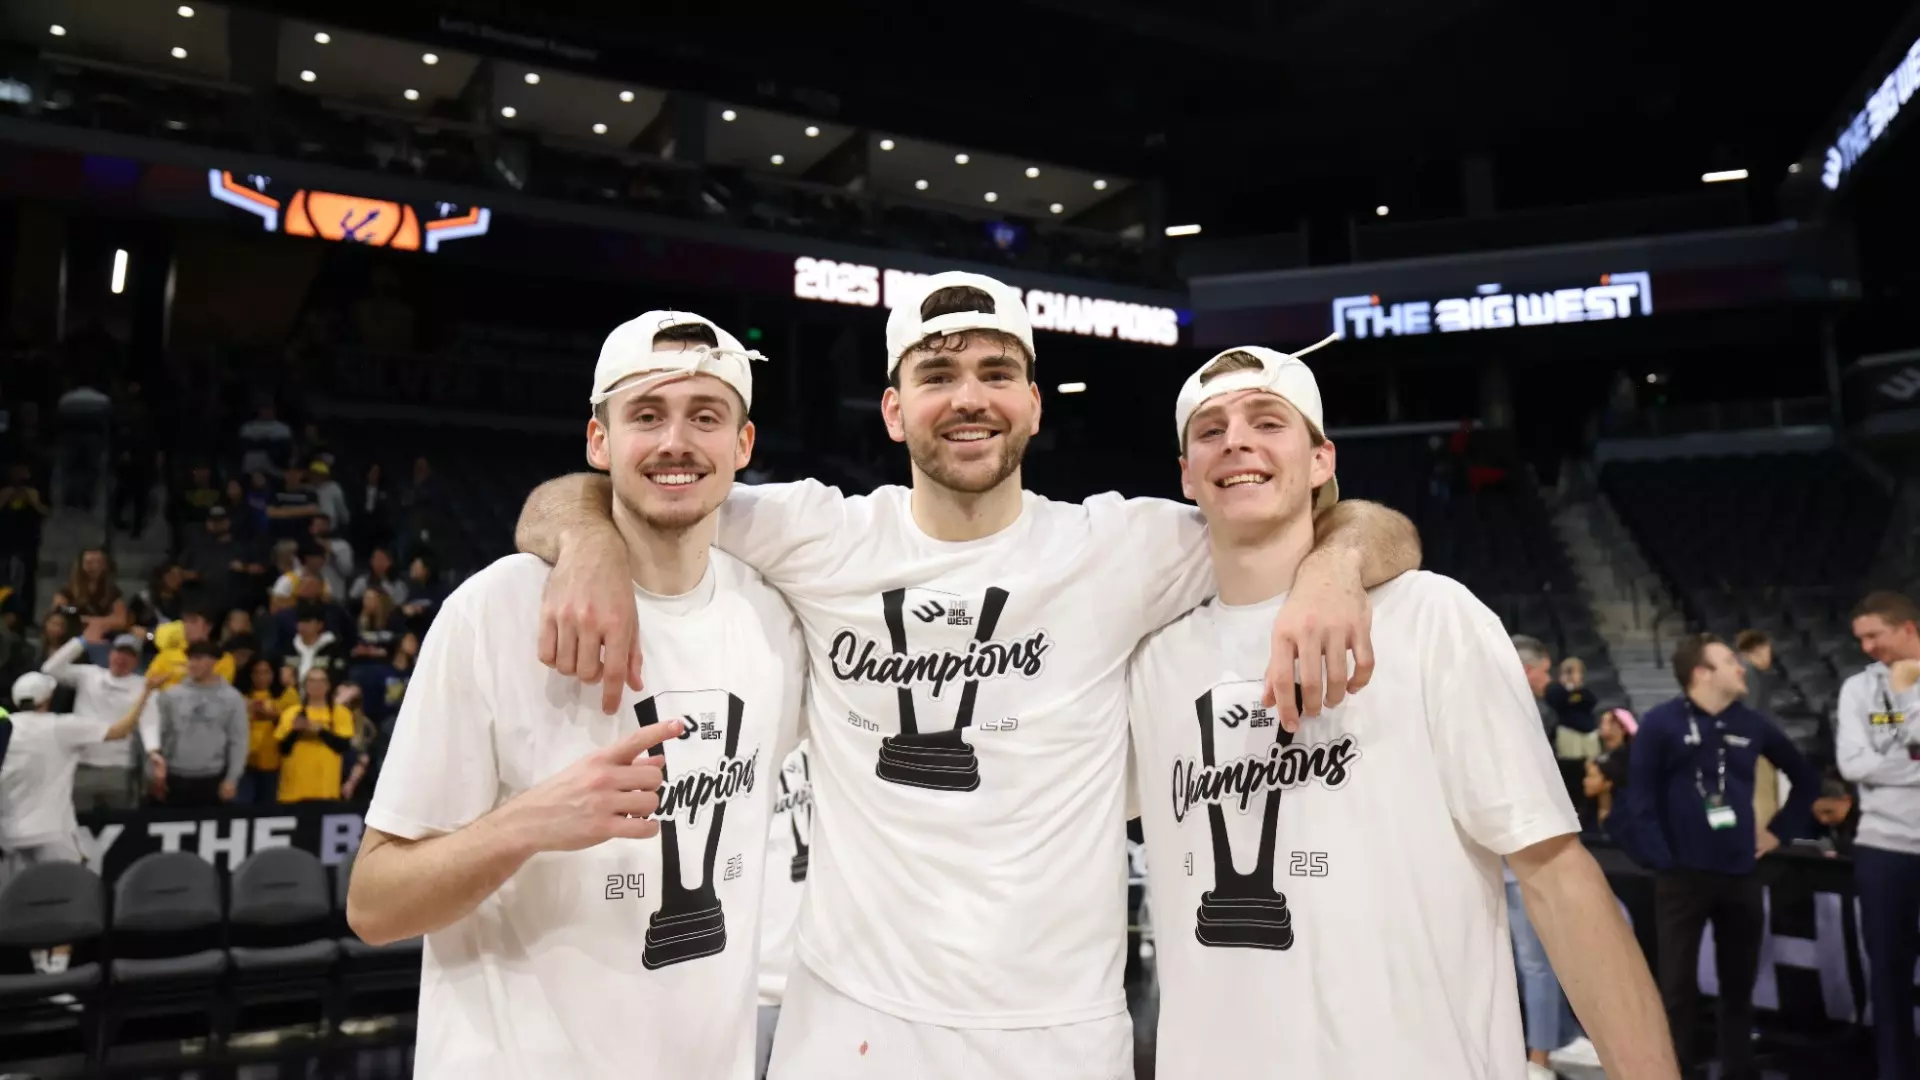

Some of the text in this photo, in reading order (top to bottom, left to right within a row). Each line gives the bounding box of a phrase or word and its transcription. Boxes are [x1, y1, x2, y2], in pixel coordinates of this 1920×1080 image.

[795, 256, 879, 306] 2025
[1027, 289, 1178, 345] CHAMPIONS
[1346, 284, 1638, 338] THE BIG WEST
[950, 600, 968, 608] THE
[947, 617, 973, 625] WEST
[829, 631, 1049, 697] Champions
[1250, 717, 1274, 728] WEST
[1251, 709, 1266, 718] BIG
[701, 722, 714, 731] BIG
[701, 730, 722, 740] WEST
[1173, 739, 1357, 823] Champions
[1290, 852, 1328, 877] 25
[605, 873, 645, 899] 24
